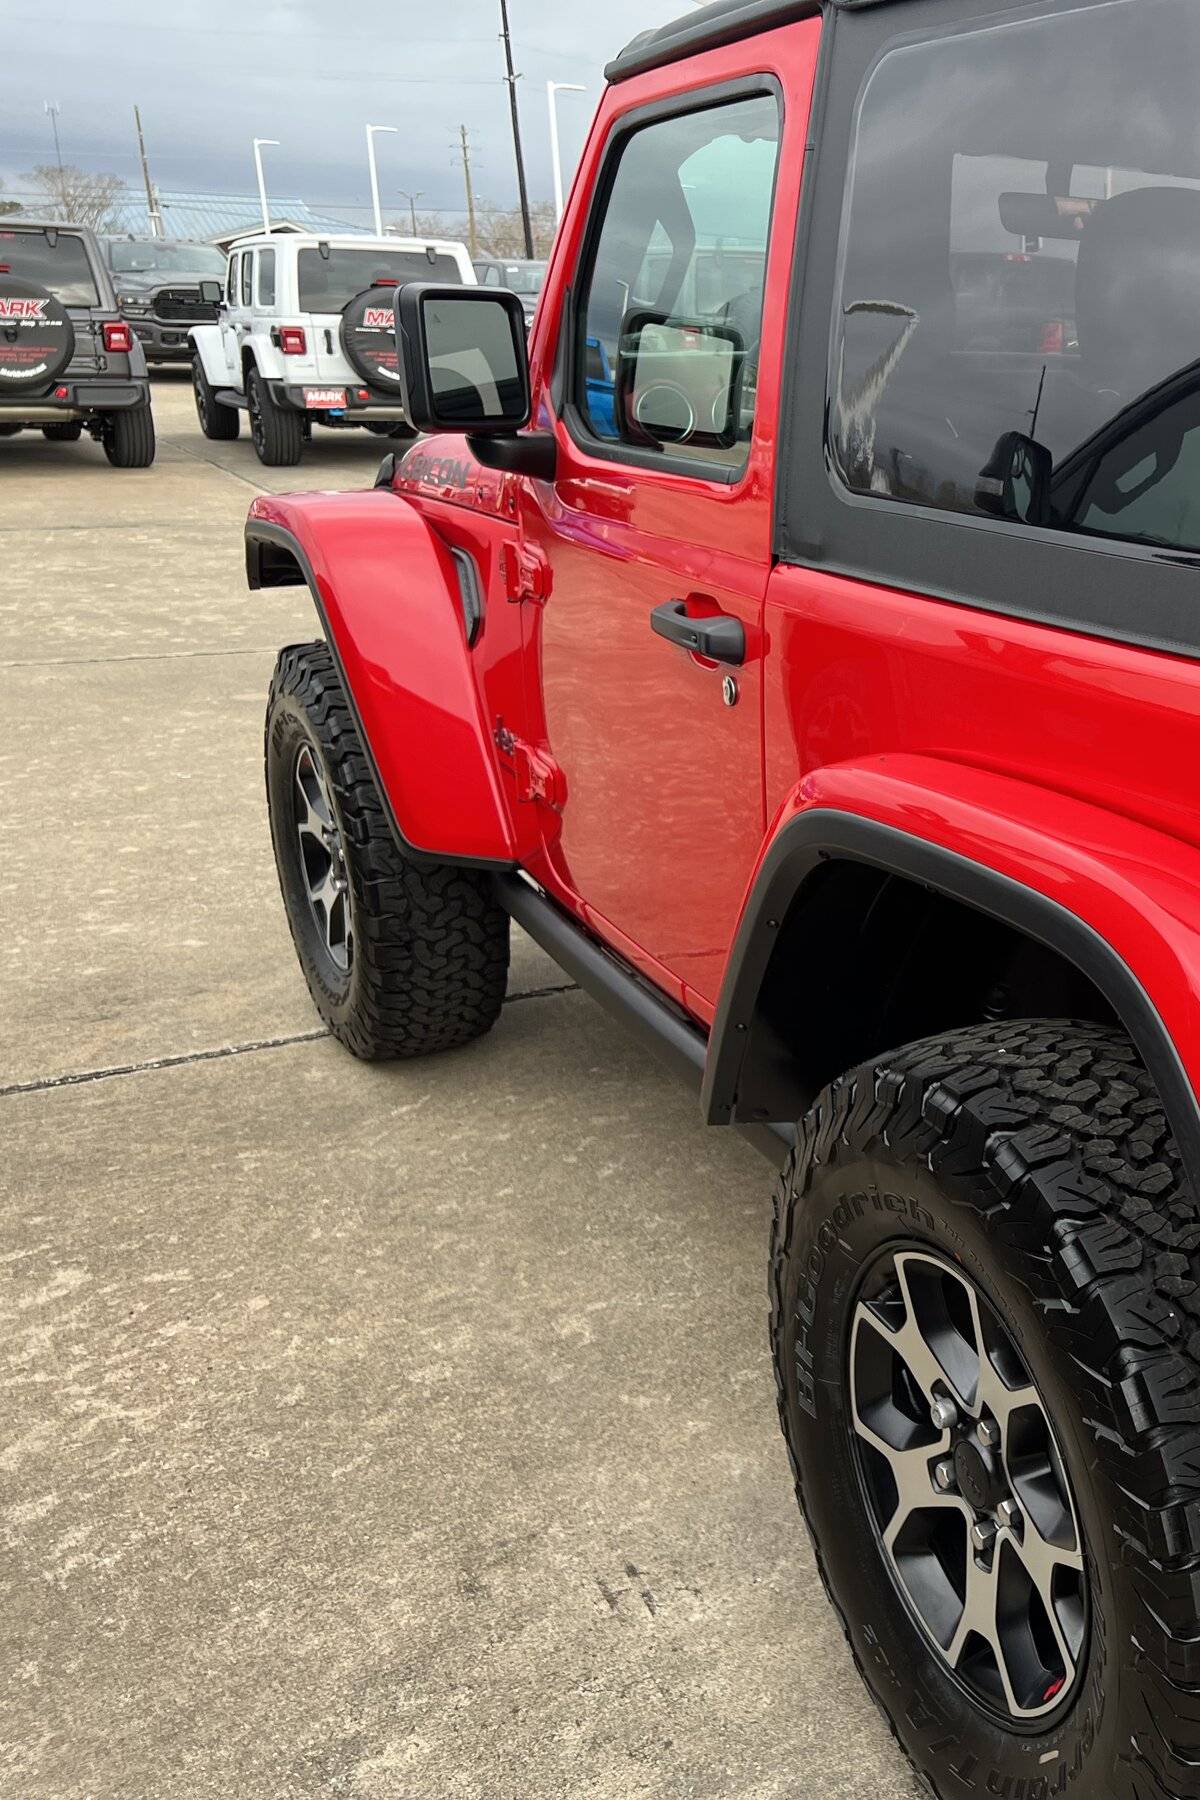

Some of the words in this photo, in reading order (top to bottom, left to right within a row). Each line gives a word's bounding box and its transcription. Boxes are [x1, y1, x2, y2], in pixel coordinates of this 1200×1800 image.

[0, 298, 49, 320] ARK
[364, 308, 395, 326] MA
[307, 390, 343, 401] MARK
